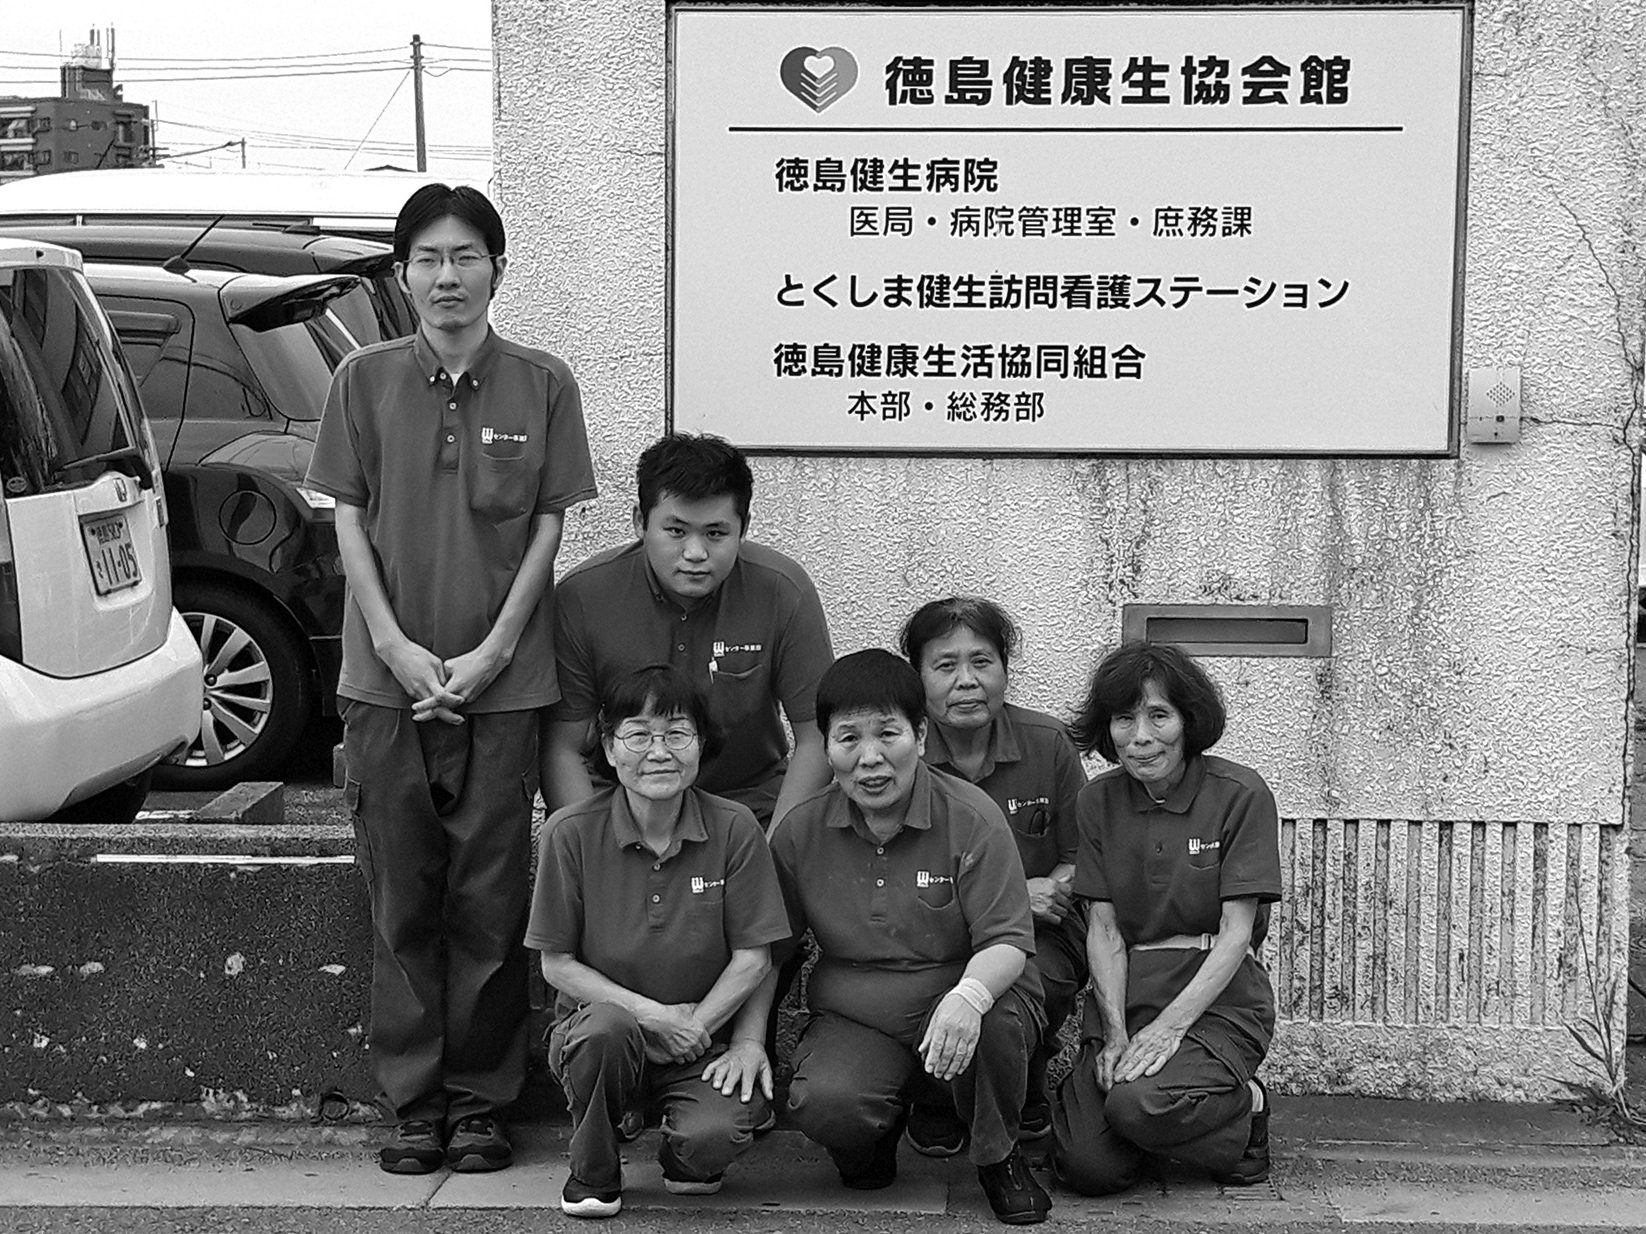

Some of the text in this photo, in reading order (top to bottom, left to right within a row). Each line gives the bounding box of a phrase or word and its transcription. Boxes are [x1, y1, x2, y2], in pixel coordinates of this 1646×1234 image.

[885, 54, 1351, 107] 徳島健康生協会館
[775, 156, 999, 193] 徳島健生病院
[850, 205, 1252, 238] 医局・病院管理室・庶務課
[776, 270, 1350, 310] とくしま健生訪問看護ステーション
[773, 342, 1146, 380] 徳島健康生活協同組合
[847, 390, 1045, 423] 本部・総務部
